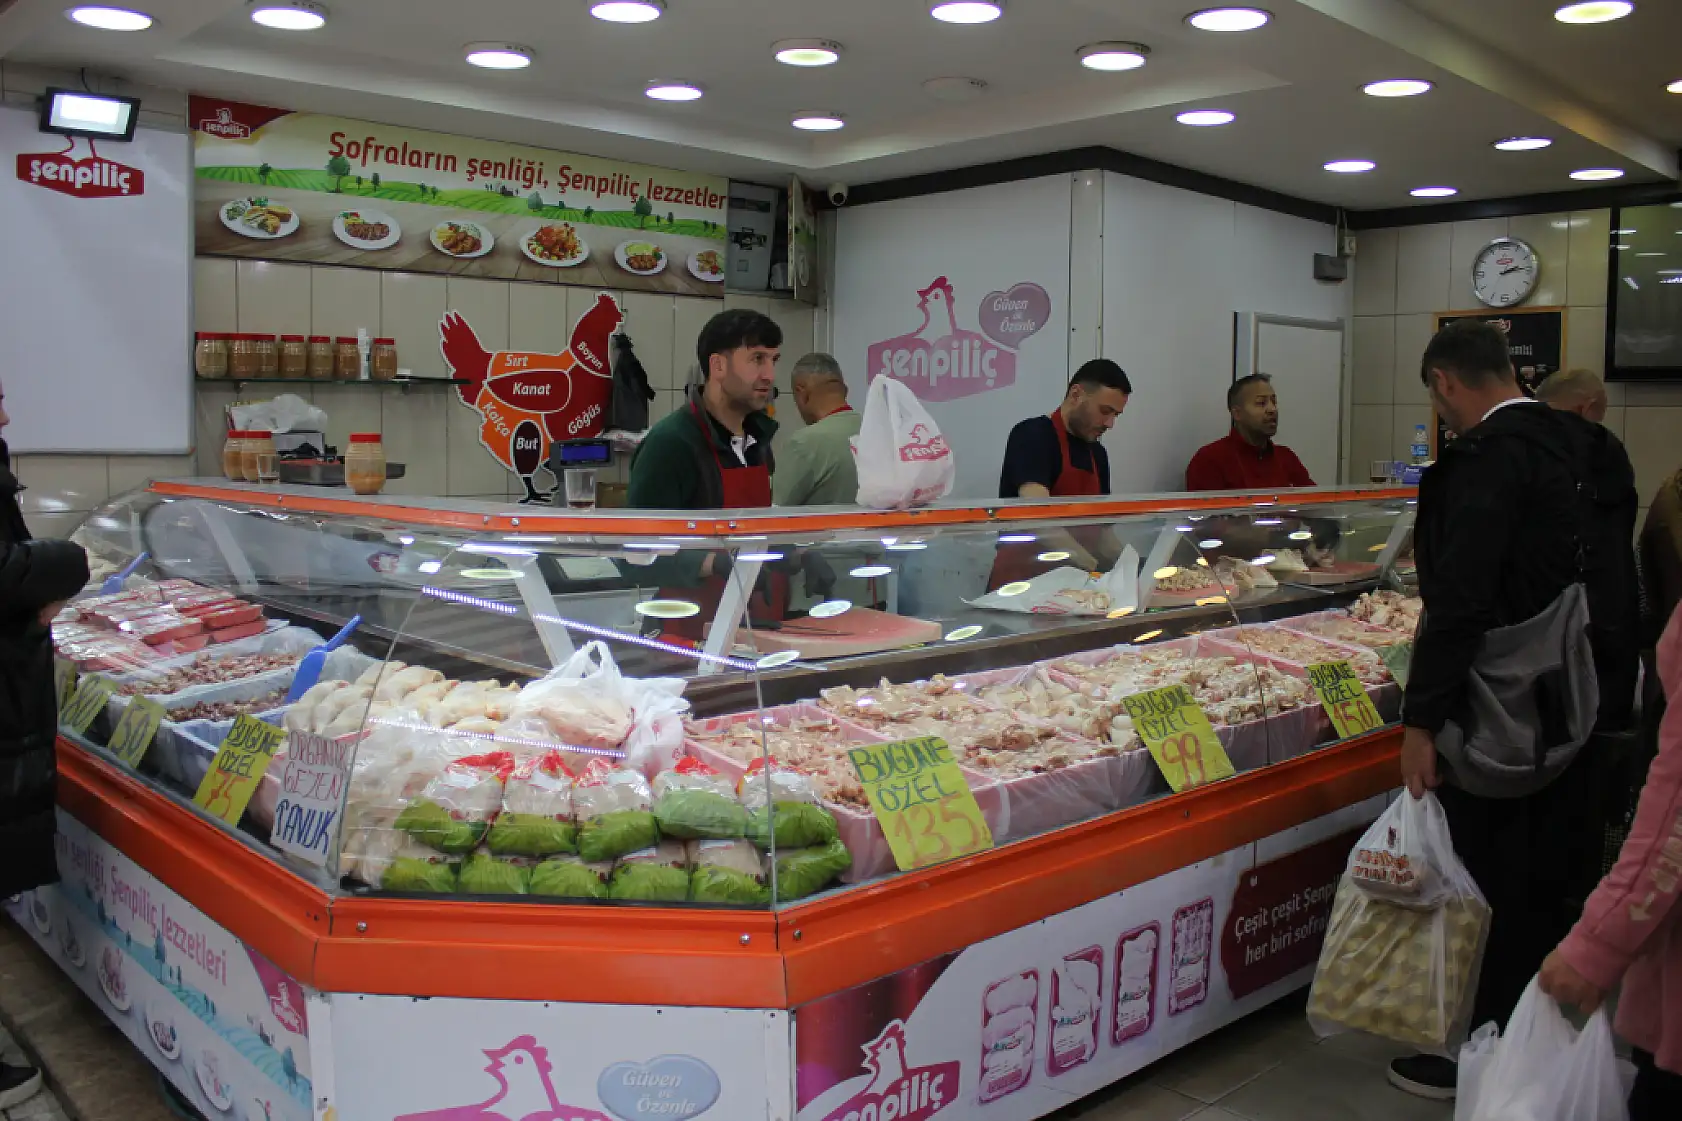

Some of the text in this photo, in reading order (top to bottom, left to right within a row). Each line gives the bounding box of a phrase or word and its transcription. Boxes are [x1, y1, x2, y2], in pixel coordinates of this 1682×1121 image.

[30, 158, 131, 195] şenpiliç
[328, 131, 727, 210] Sofraların şenliği, Şenpiliç lezzetler
[577, 340, 604, 369] Boyun
[512, 382, 551, 396] Kanat
[568, 404, 602, 435] Göğüs
[516, 436, 539, 450] But
[1162, 731, 1205, 789] 99
[204, 767, 249, 819] 75
[275, 799, 337, 856] TAVUK
[894, 793, 981, 869] 135
[1235, 906, 1268, 943] Çeşit
[1272, 892, 1301, 927] çeşit
[160, 902, 227, 986] lezzetleri
[1245, 943, 1269, 967] her
[622, 1070, 682, 1088] Güven
[636, 1094, 697, 1114] Özenle
